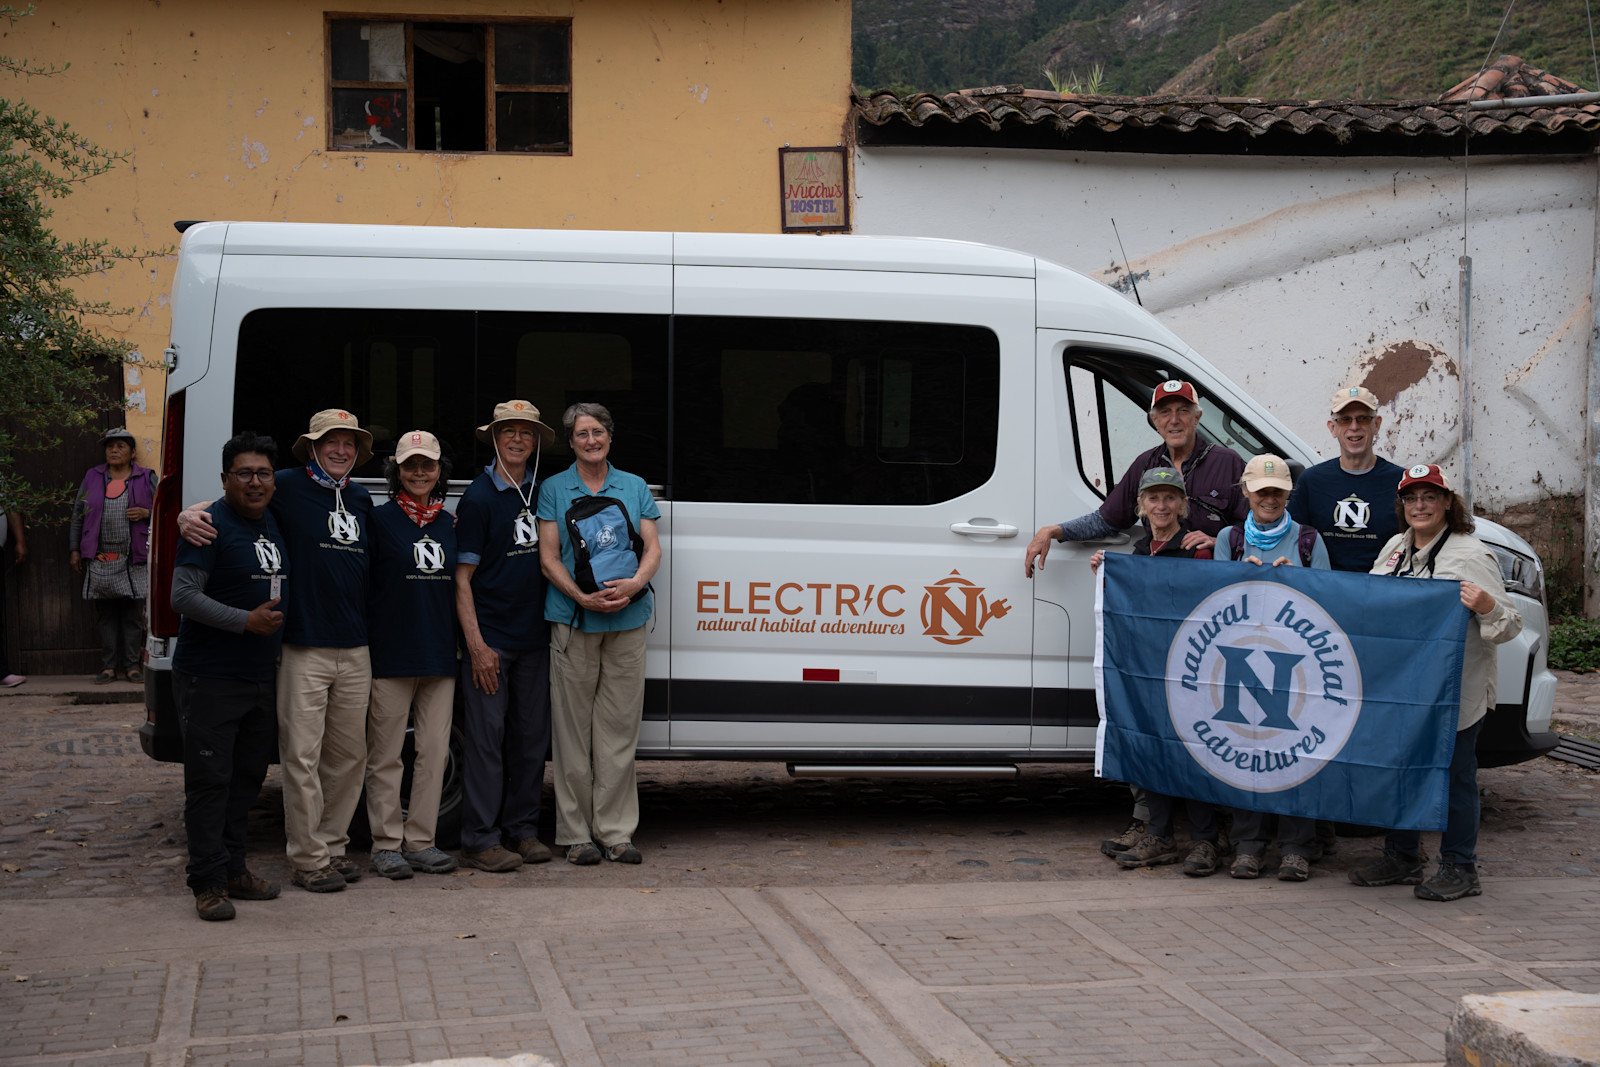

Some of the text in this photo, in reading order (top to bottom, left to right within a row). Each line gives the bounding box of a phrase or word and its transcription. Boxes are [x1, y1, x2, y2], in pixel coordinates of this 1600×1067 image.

[790, 199, 836, 213] HOSTEL
[329, 511, 360, 541] N
[1334, 501, 1370, 528] N
[514, 515, 539, 545] N
[253, 542, 282, 569] N
[413, 542, 445, 569] N
[696, 617, 905, 635] natural habitat adventures
[922, 586, 986, 636] N
[1181, 593, 1348, 706] natural habitat
[1211, 644, 1307, 731] N
[1193, 720, 1326, 773] adventures
